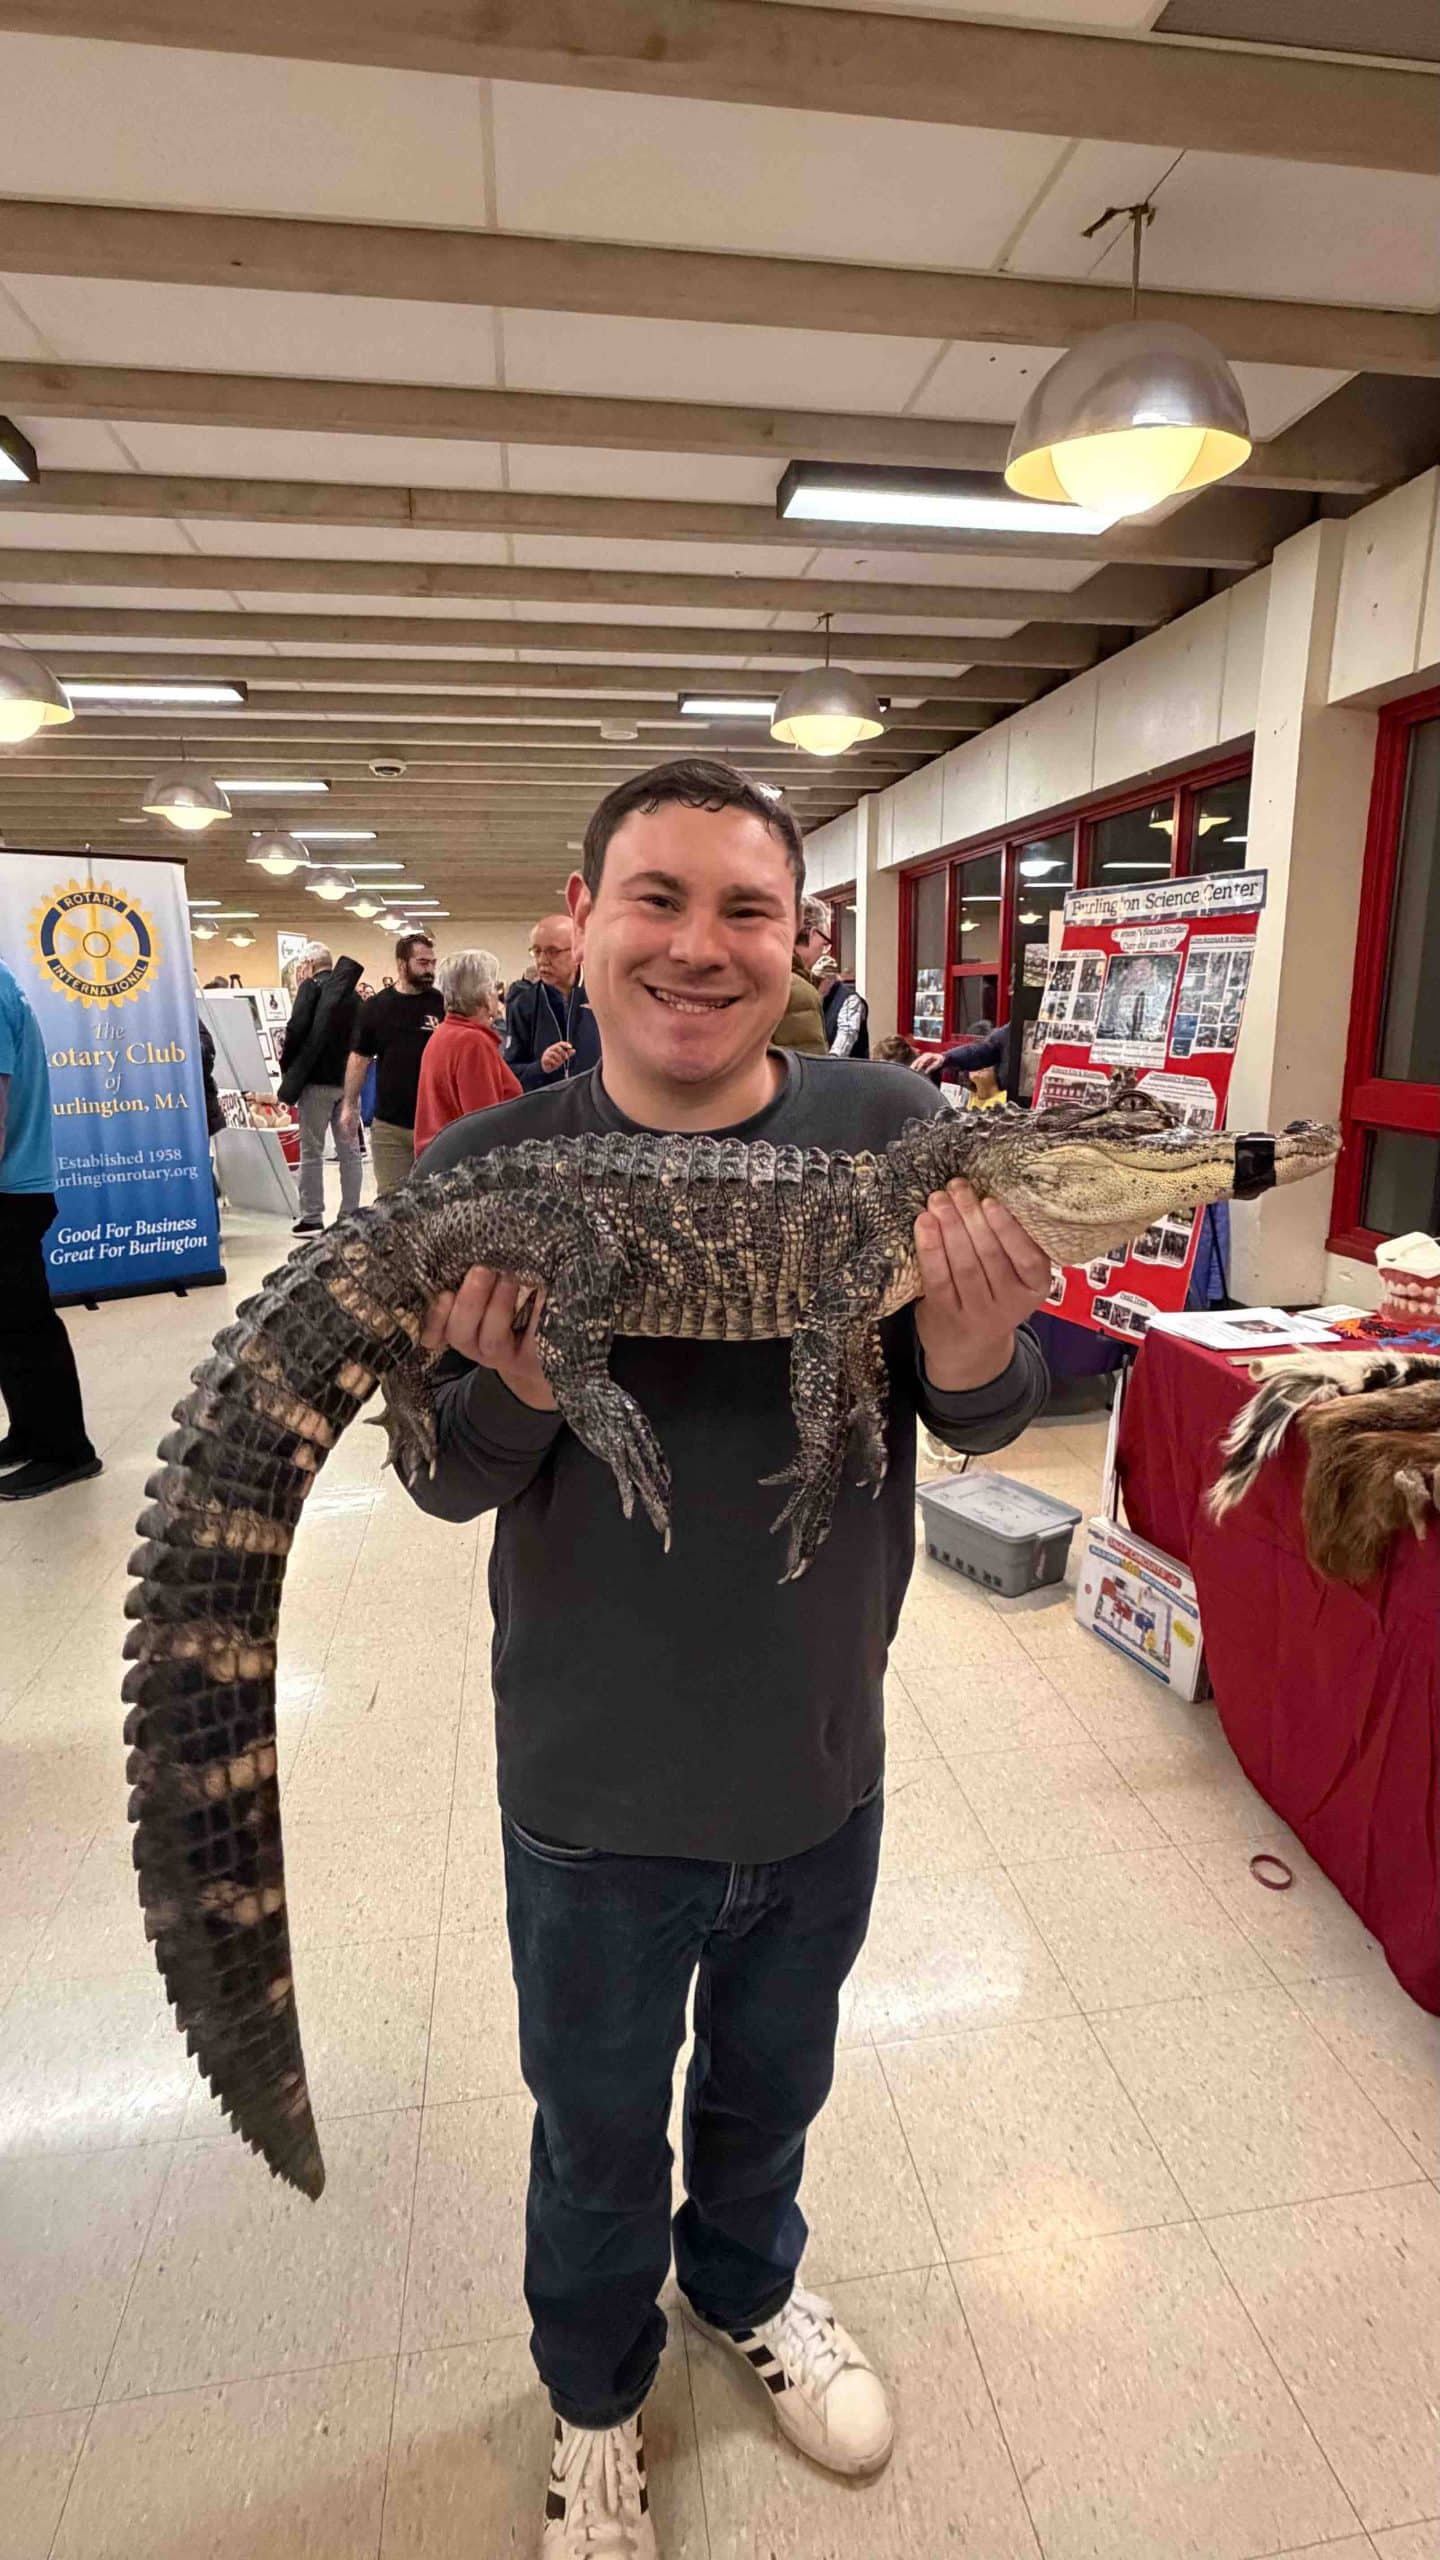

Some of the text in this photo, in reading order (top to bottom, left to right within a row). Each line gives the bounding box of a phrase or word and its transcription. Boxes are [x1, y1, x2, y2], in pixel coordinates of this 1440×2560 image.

[64, 893, 120, 907] ROTARY
[1145, 891, 1199, 909] Science
[52, 963, 147, 996] INTERNATIONAL
[94, 1021, 125, 1040] The
[48, 1041, 187, 1073] otary Club
[105, 1073, 121, 1095] of
[52, 1093, 189, 1119] urlington, MA
[58, 1148, 182, 1170] Established 1958
[55, 1166, 199, 1188] urlingtonrotary.org
[57, 1217, 198, 1245] Good For Business
[50, 1235, 208, 1266] Great For Burlington
